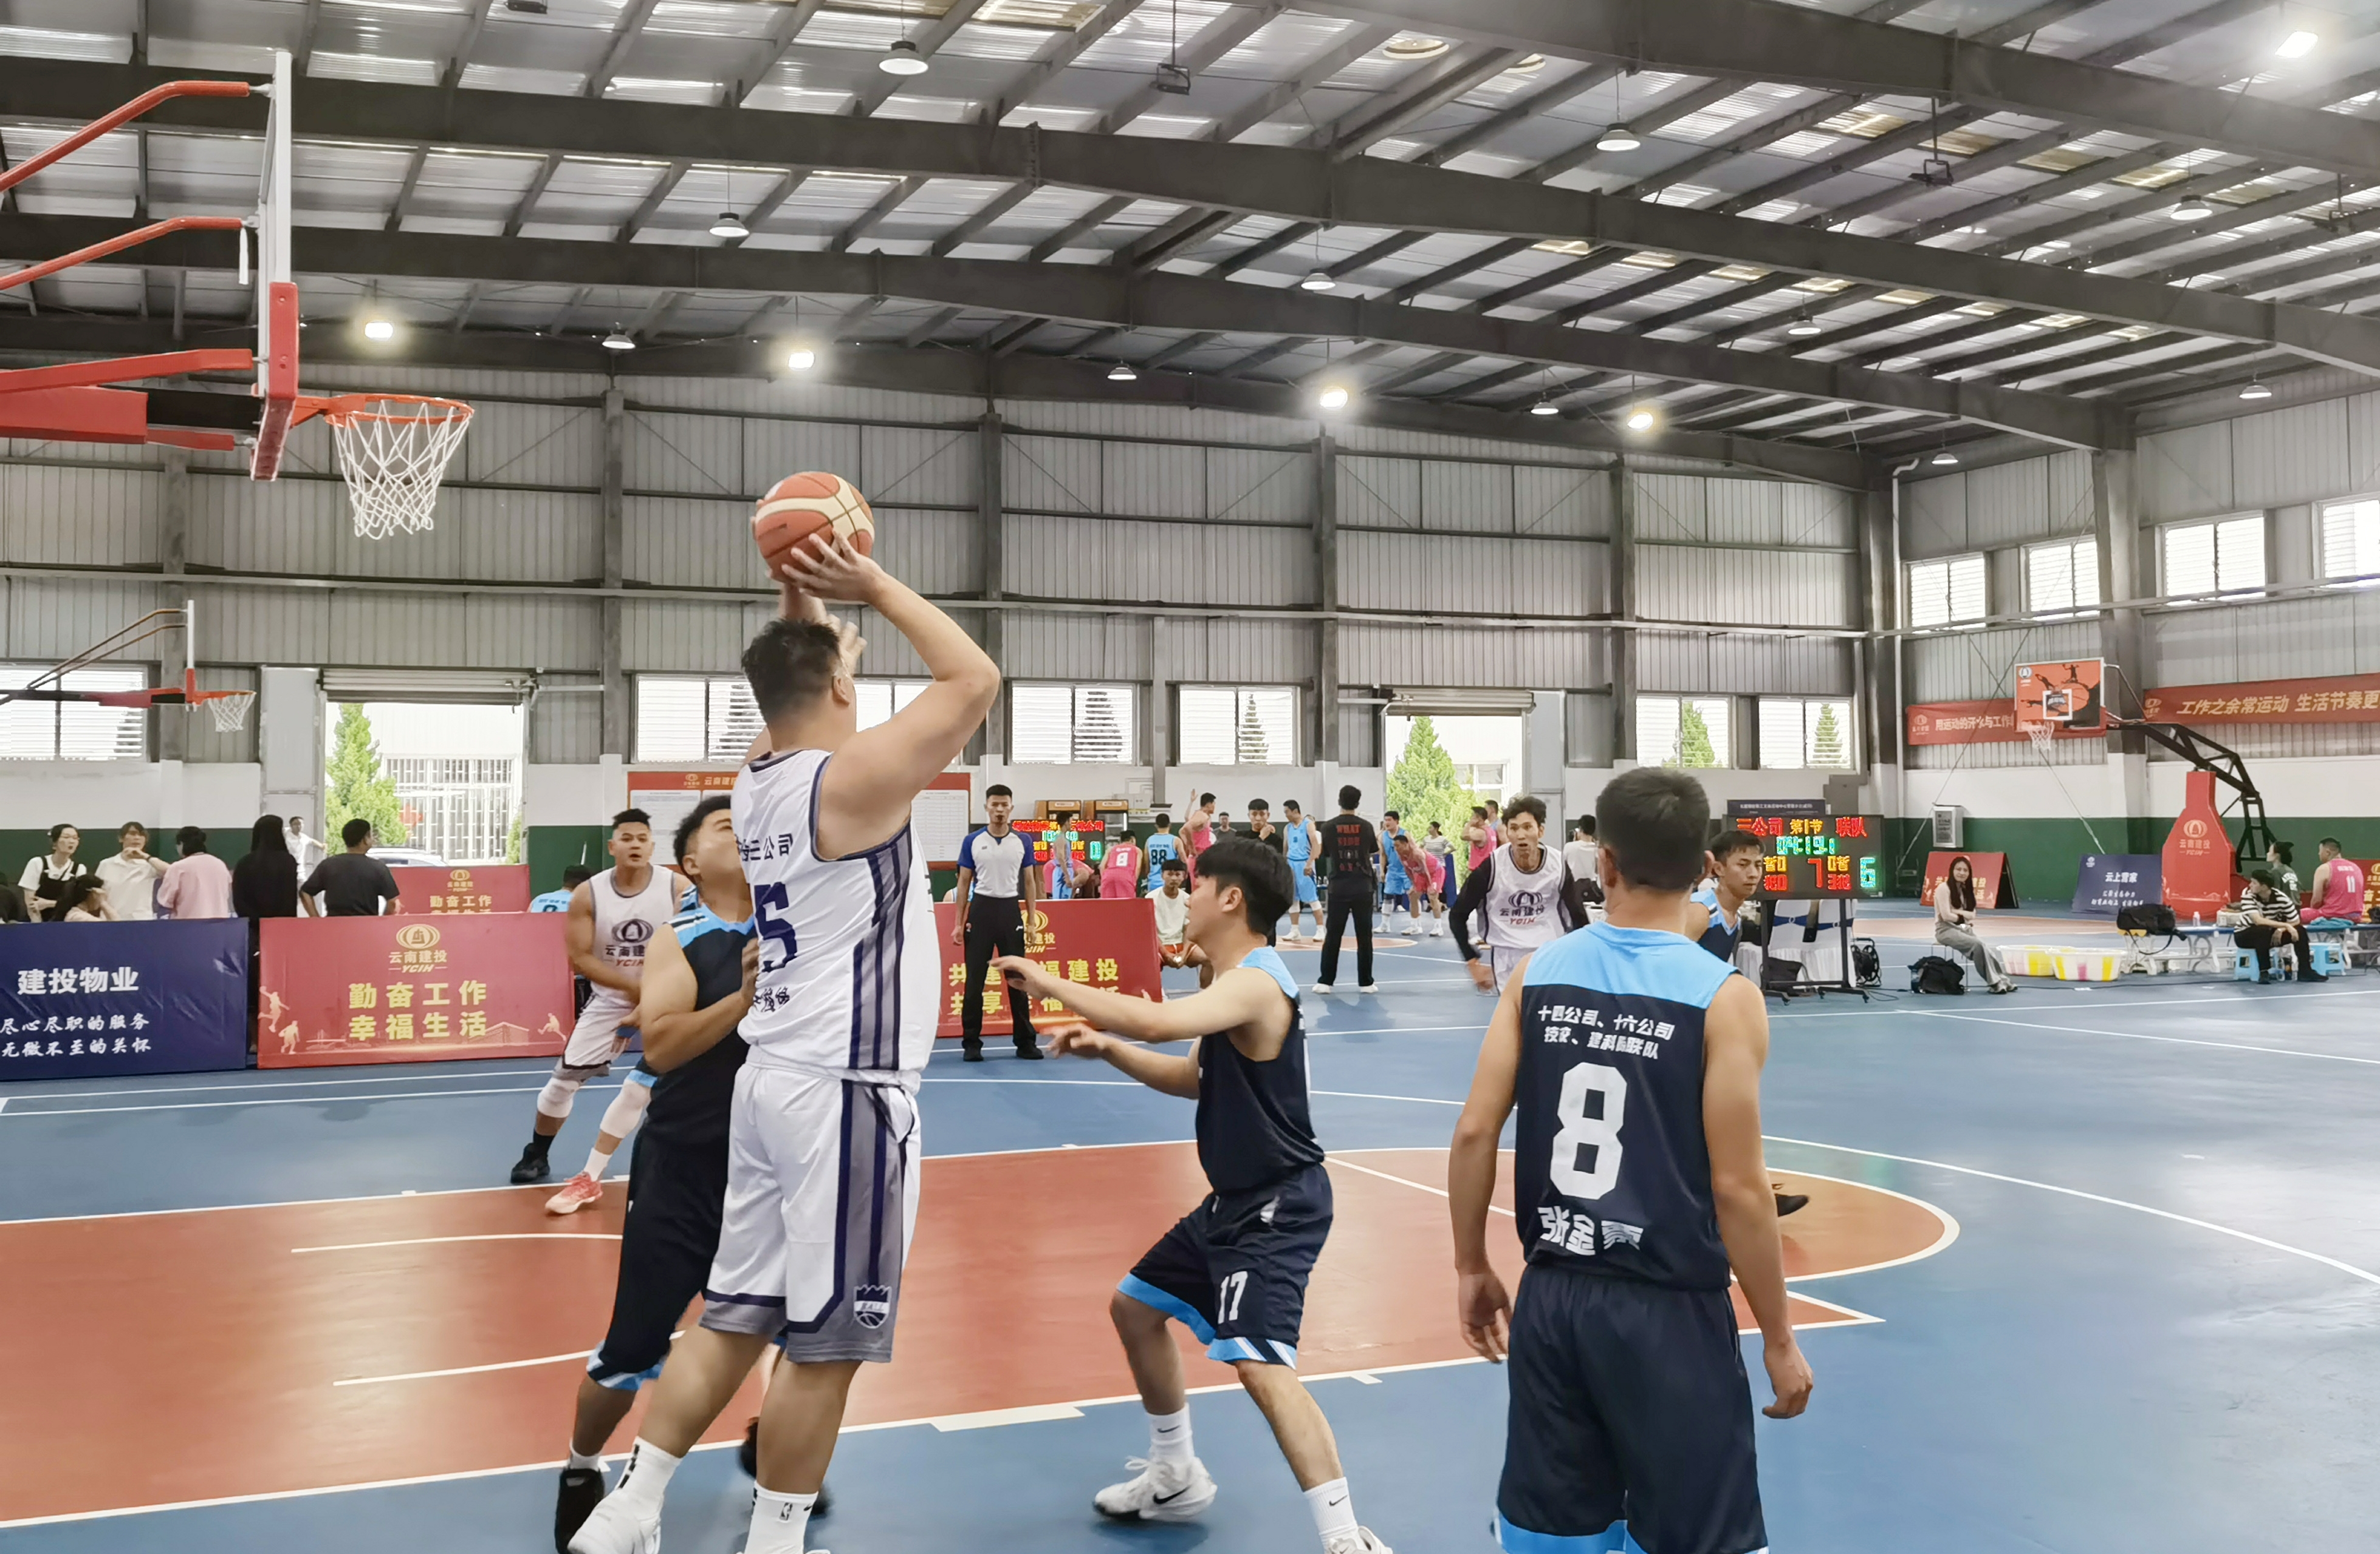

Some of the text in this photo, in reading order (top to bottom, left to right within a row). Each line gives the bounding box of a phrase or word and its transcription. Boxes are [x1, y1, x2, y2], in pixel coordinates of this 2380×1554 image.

[2176, 696, 2289, 715] 工作之余常运动
[1836, 817, 1868, 837] 联队
[1808, 858, 1823, 888] 7
[1860, 857, 1876, 887] 6
[430, 895, 492, 908] 勤奋工作
[388, 949, 447, 964] 云南建投
[401, 964, 434, 973] YCIH
[17, 966, 139, 995] 建投物业
[348, 980, 487, 1009] 勤奋工作
[0, 1013, 149, 1035] 尽心尽职的服务
[348, 1010, 487, 1041] 幸福生活
[1, 1037, 151, 1057] 无微不至的关怀
[1550, 1062, 1627, 1200] 8
[1217, 1270, 1248, 1325] 17
